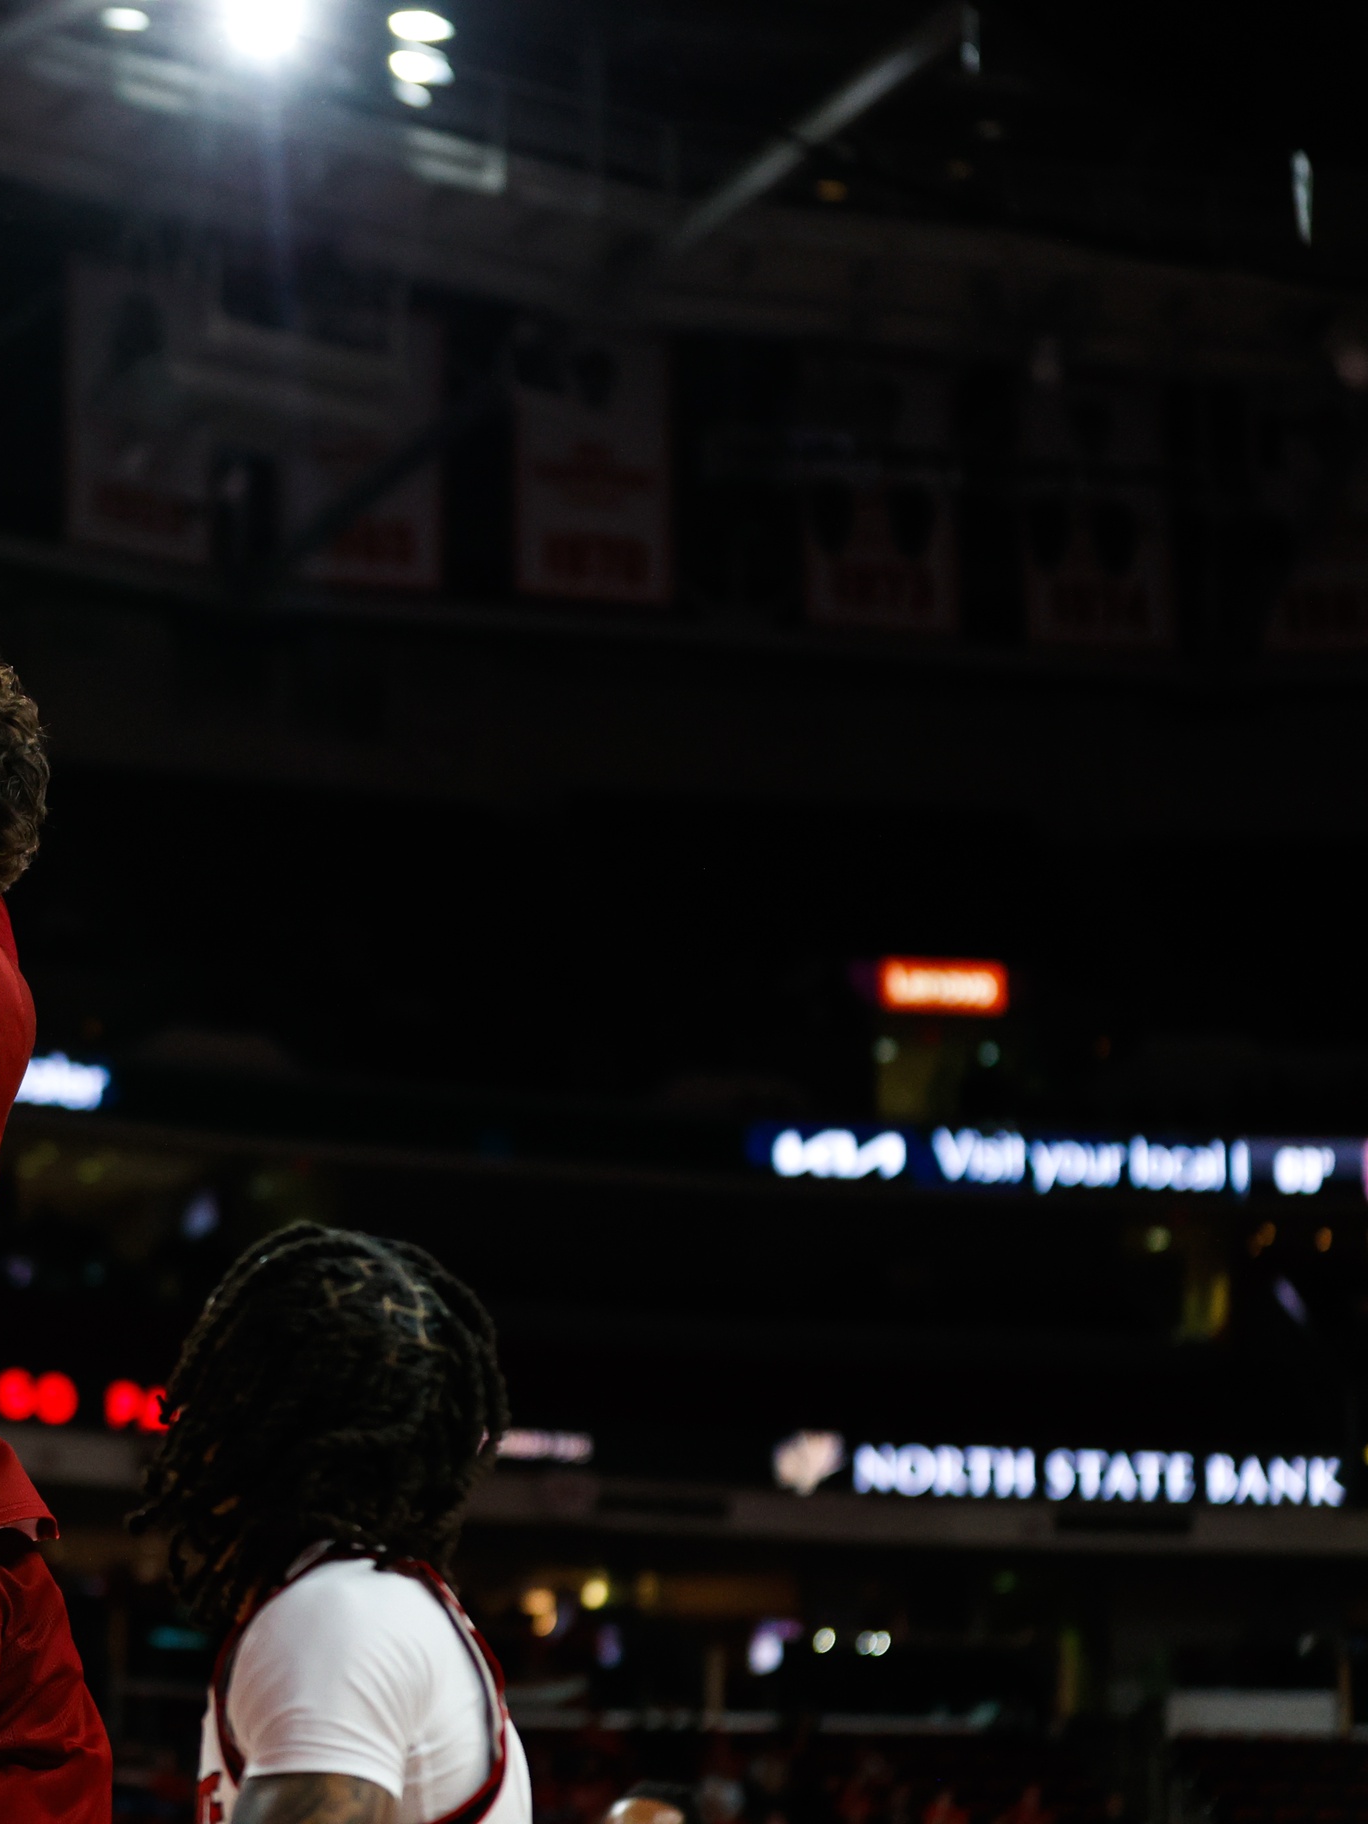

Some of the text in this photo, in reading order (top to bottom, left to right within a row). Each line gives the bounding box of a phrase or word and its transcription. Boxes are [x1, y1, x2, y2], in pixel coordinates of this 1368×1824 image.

[853, 1442, 1345, 1507] NORTH STATE BANK
